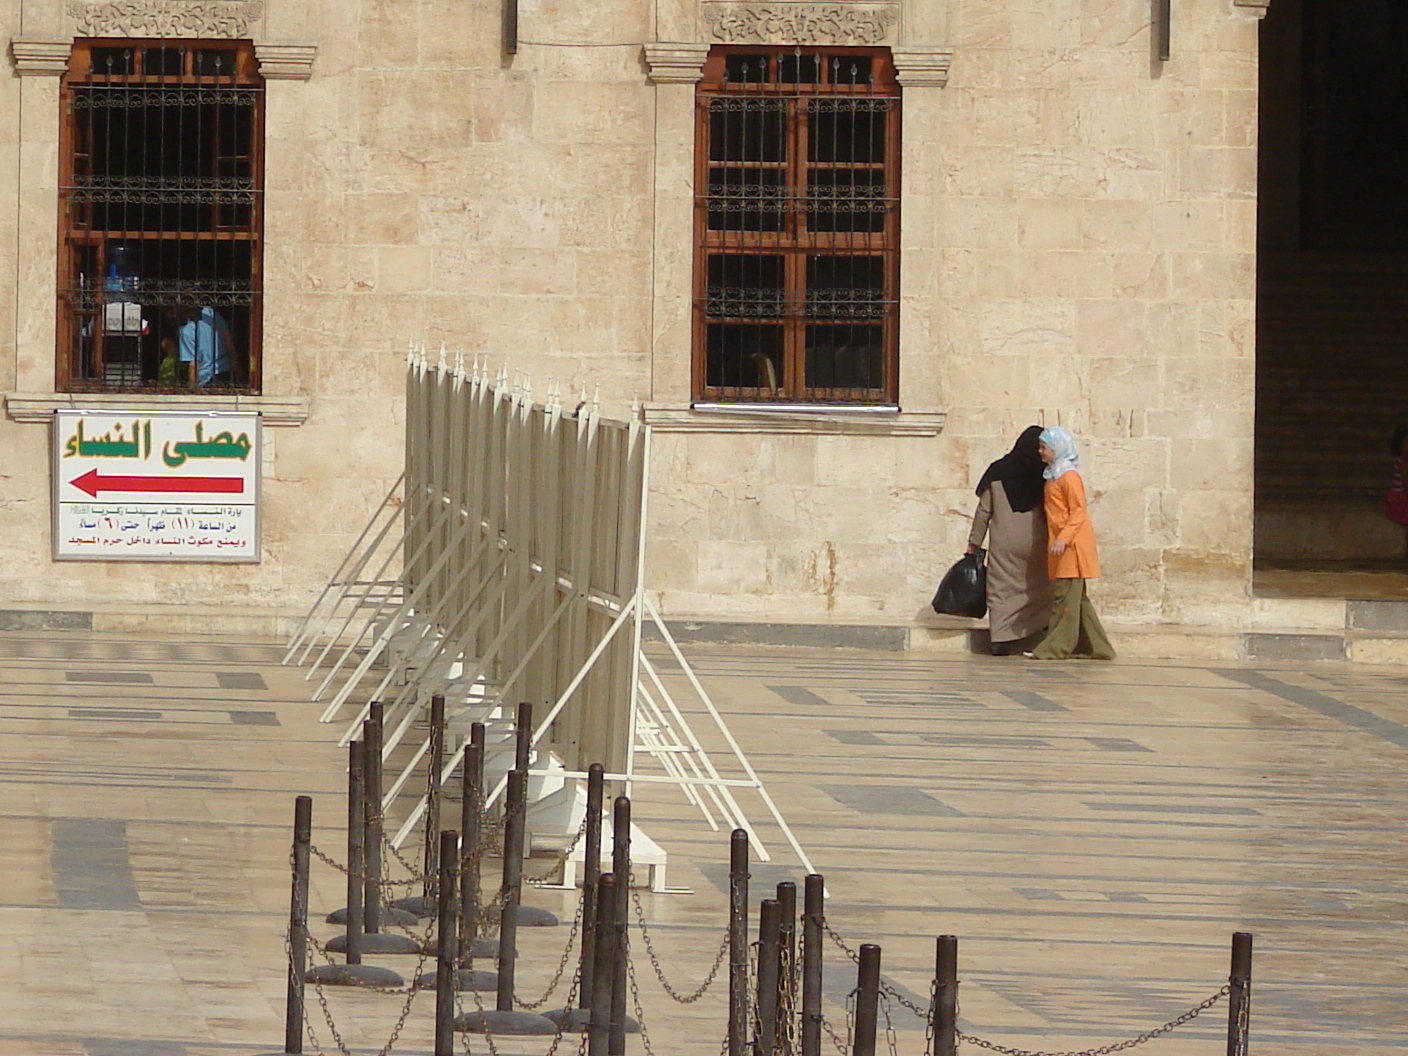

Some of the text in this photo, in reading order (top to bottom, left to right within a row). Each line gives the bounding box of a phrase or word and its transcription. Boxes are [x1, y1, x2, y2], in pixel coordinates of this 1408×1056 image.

[62, 418, 252, 468] مصلى النساء
[91, 505, 124, 516] زكريا
[125, 506, 158, 517] سيدنا
[187, 506, 226, 516] النساء
[120, 520, 140, 531] حتى
[198, 519, 224, 531] الساعة
[225, 522, 237, 532] من
[68, 535, 247, 548] ويمنع مكوث النساء داخل حرم المسجد
